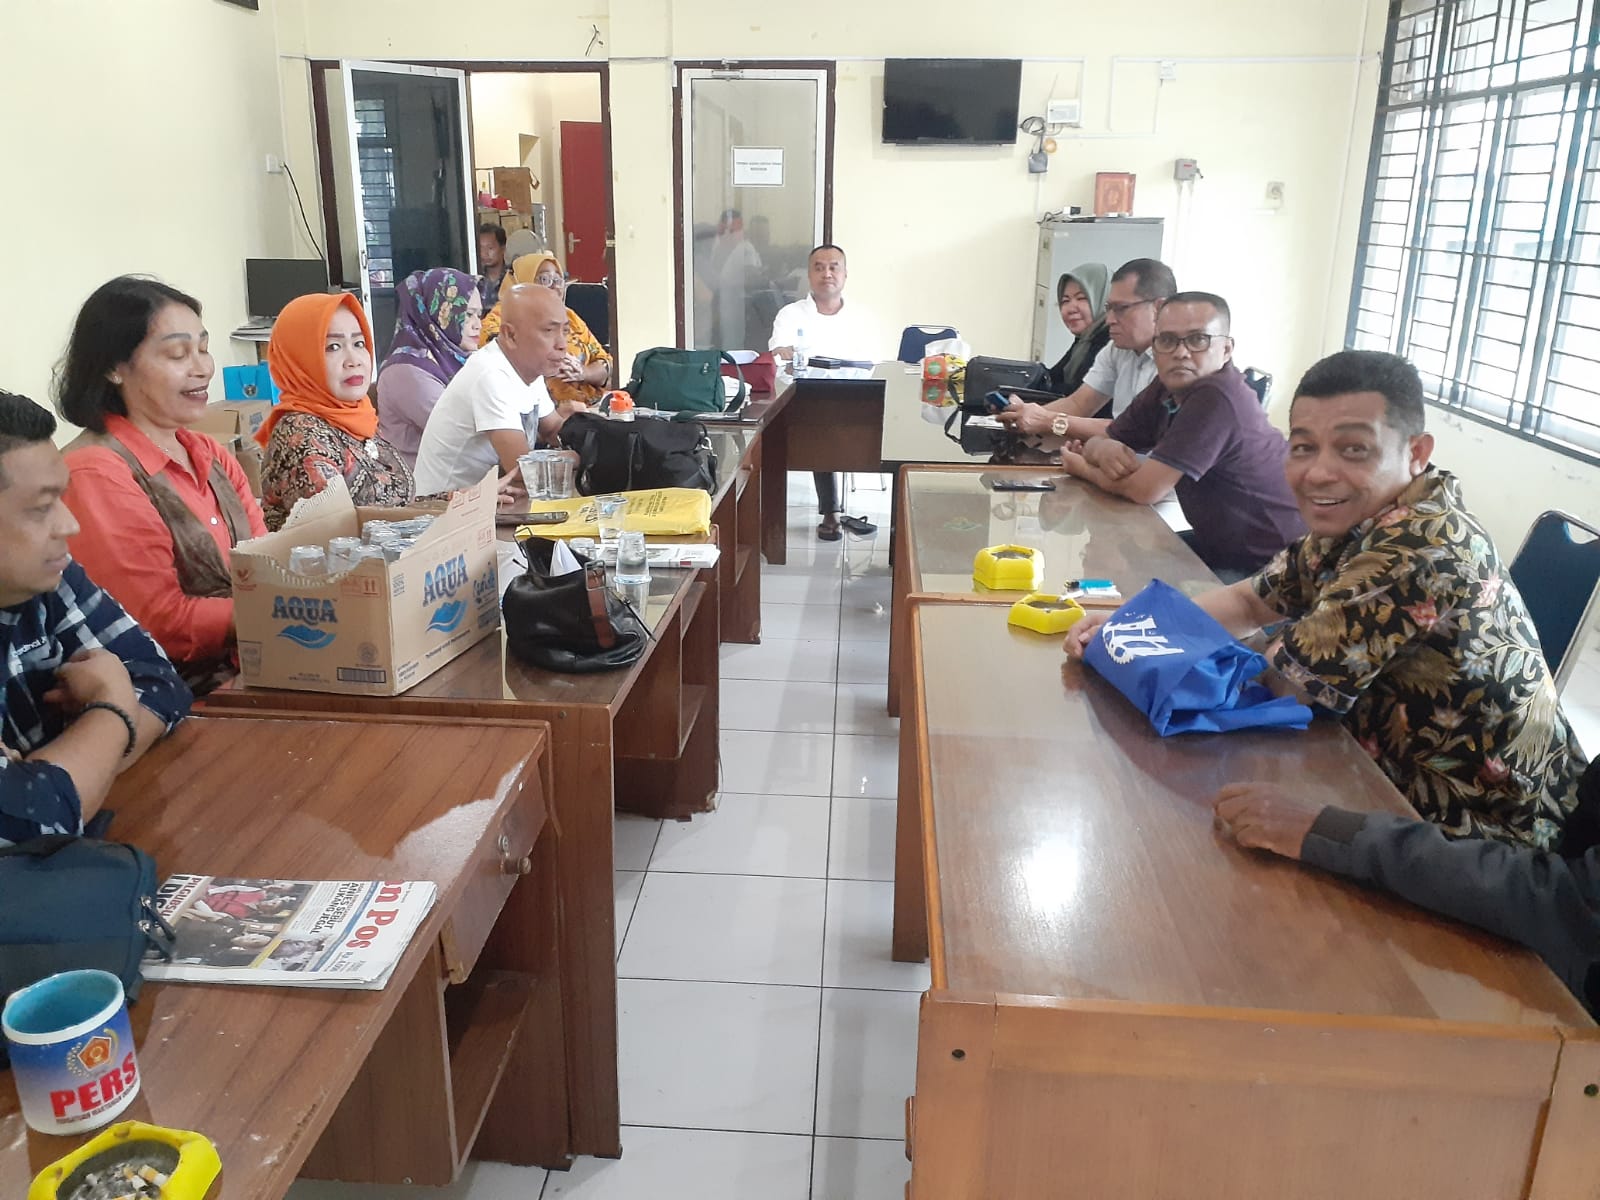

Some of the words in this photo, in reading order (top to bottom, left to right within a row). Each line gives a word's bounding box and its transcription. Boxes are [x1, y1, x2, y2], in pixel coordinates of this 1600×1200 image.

[422, 552, 469, 608] AQUA
[271, 595, 338, 625] AQUA
[326, 882, 351, 912] TUKANG
[340, 882, 360, 906] ANIES
[309, 912, 331, 935] JEGAL
[323, 906, 346, 929] SEBUT
[346, 908, 399, 949] Pos
[50, 1051, 137, 1118] PERS
